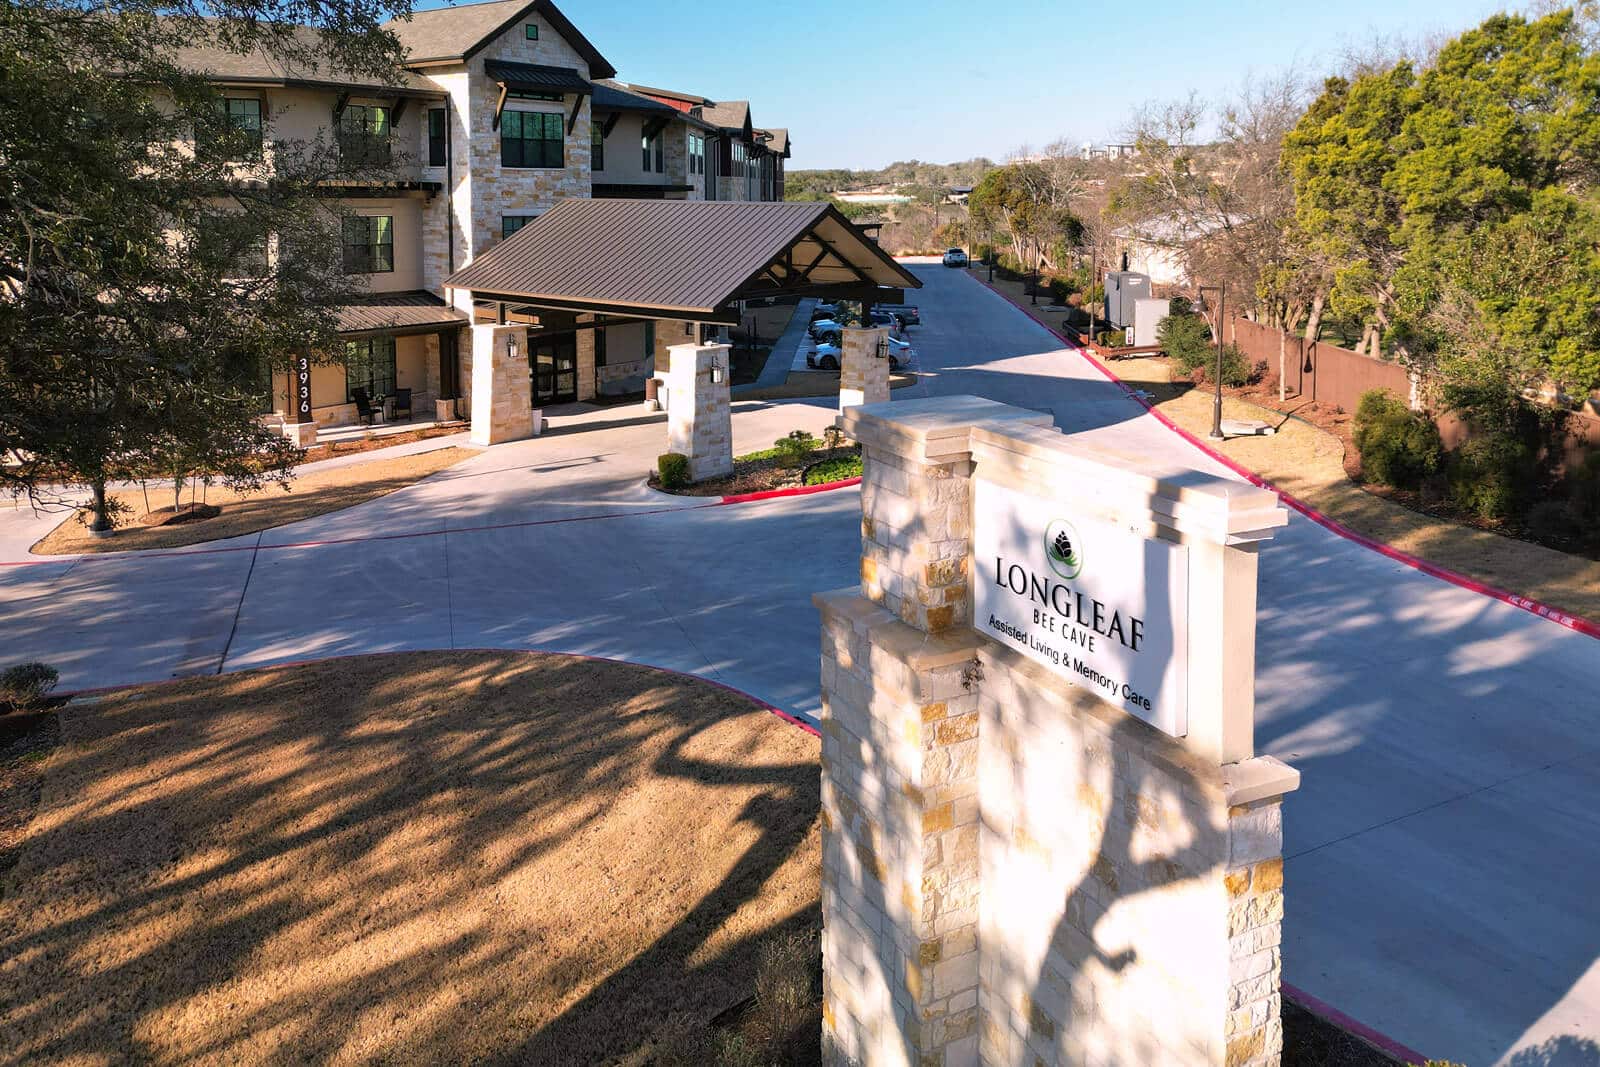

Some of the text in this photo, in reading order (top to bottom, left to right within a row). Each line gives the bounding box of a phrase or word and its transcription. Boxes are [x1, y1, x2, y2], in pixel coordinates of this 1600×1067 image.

[300, 358, 309, 412] 3936
[996, 557, 1143, 652] LONGLEAF
[1033, 608, 1095, 653] BEE CAVE
[988, 613, 1151, 711] Assisted Living & Memory Care
